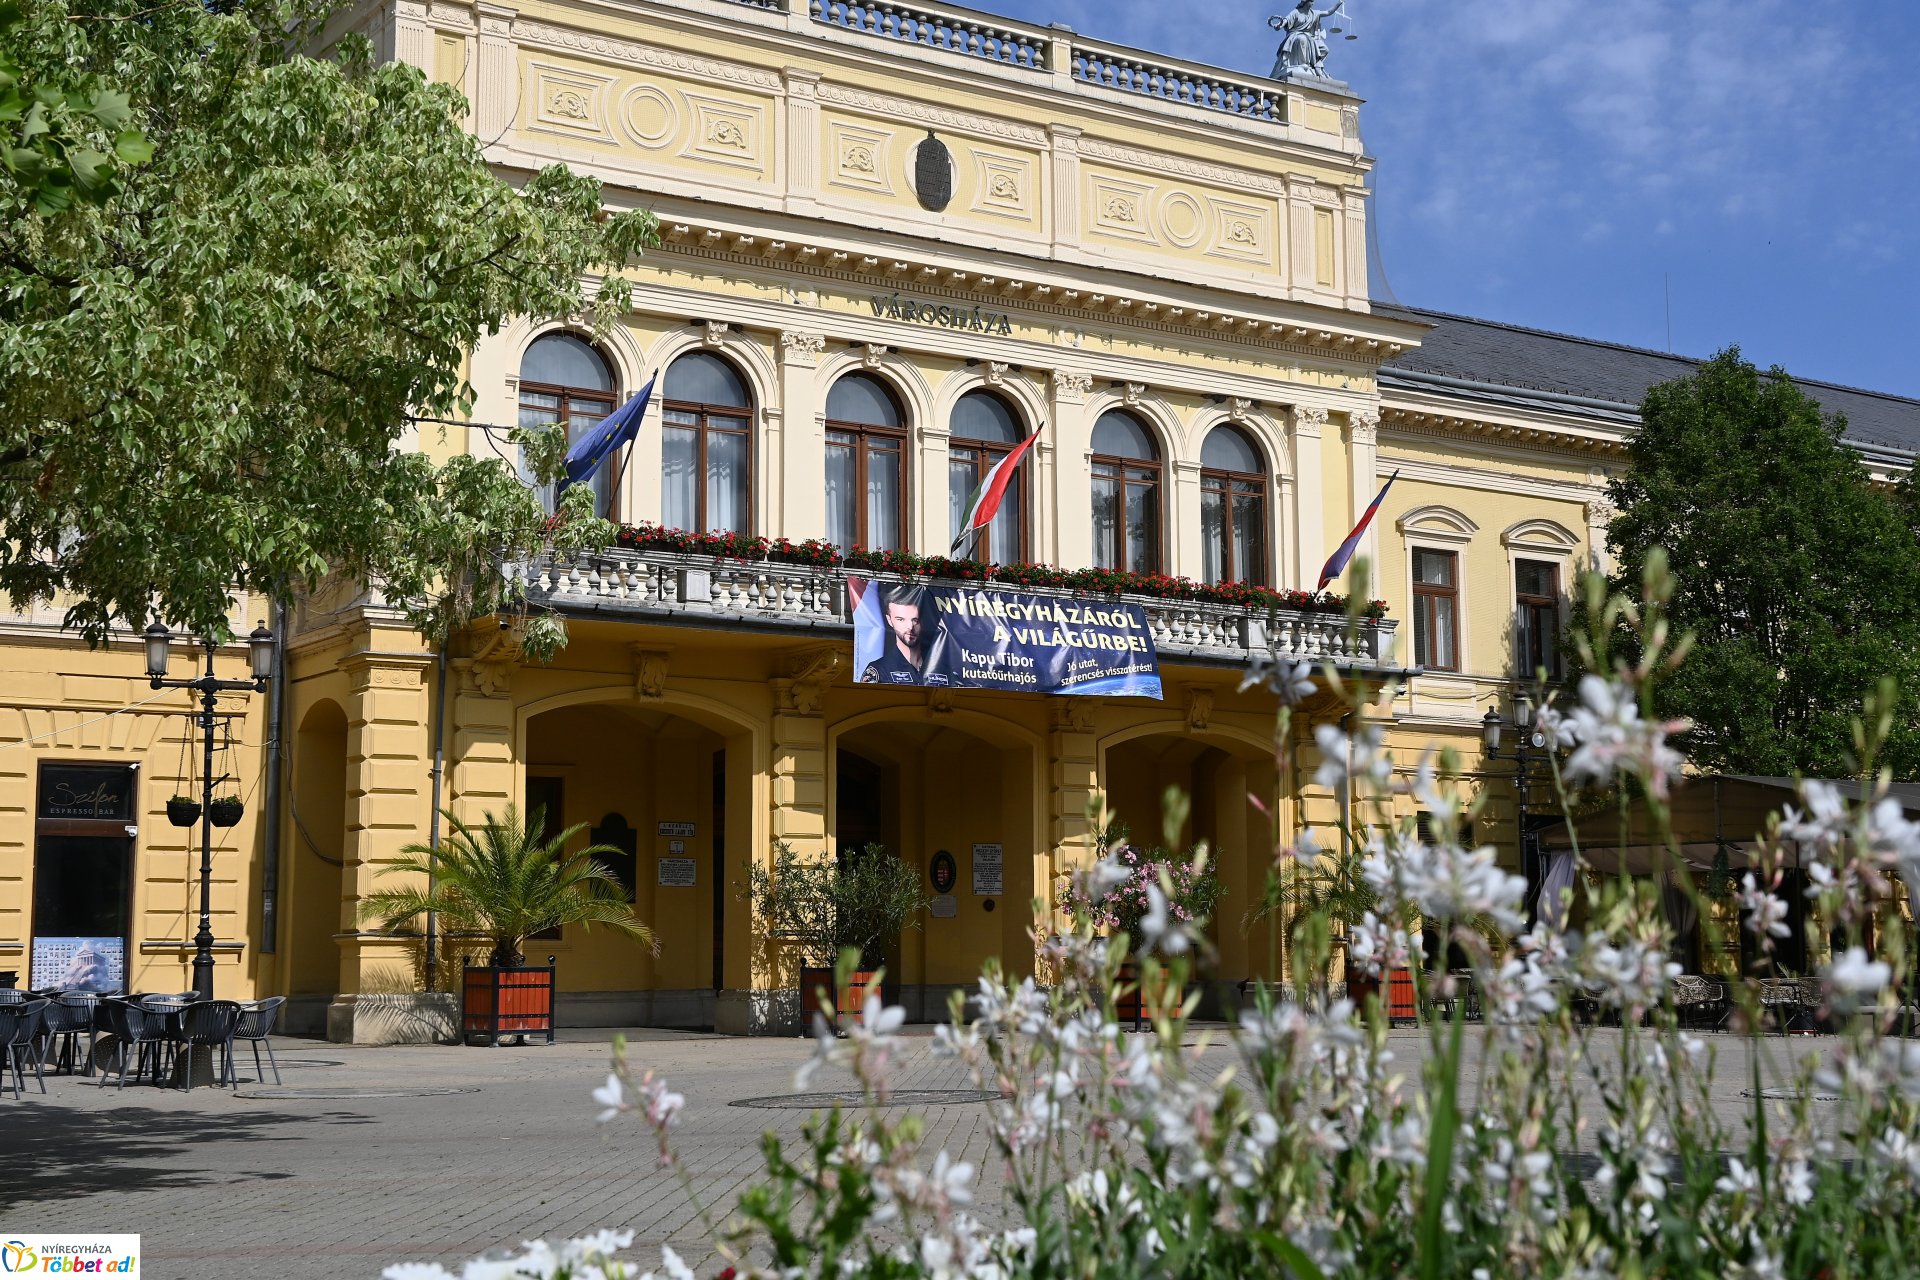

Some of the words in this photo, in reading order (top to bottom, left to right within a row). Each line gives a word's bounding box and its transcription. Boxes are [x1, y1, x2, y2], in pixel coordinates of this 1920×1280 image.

[870, 293, 1012, 335] VÁROSHÁZA
[935, 596, 1141, 629] NYÍREGYHÁZÁRÓL
[993, 625, 1011, 643] A
[1013, 626, 1148, 653] VILÁGŰRBE!
[962, 648, 996, 667] Kapu
[998, 652, 1034, 667] Tibor
[1067, 662, 1077, 672] Jó
[1079, 658, 1099, 669] utat,
[962, 667, 1037, 685] kutatóűrhajós
[1061, 668, 1104, 686] szerencsés
[1105, 663, 1153, 677] visszatérést!
[50, 807, 93, 815] ESPRESSO
